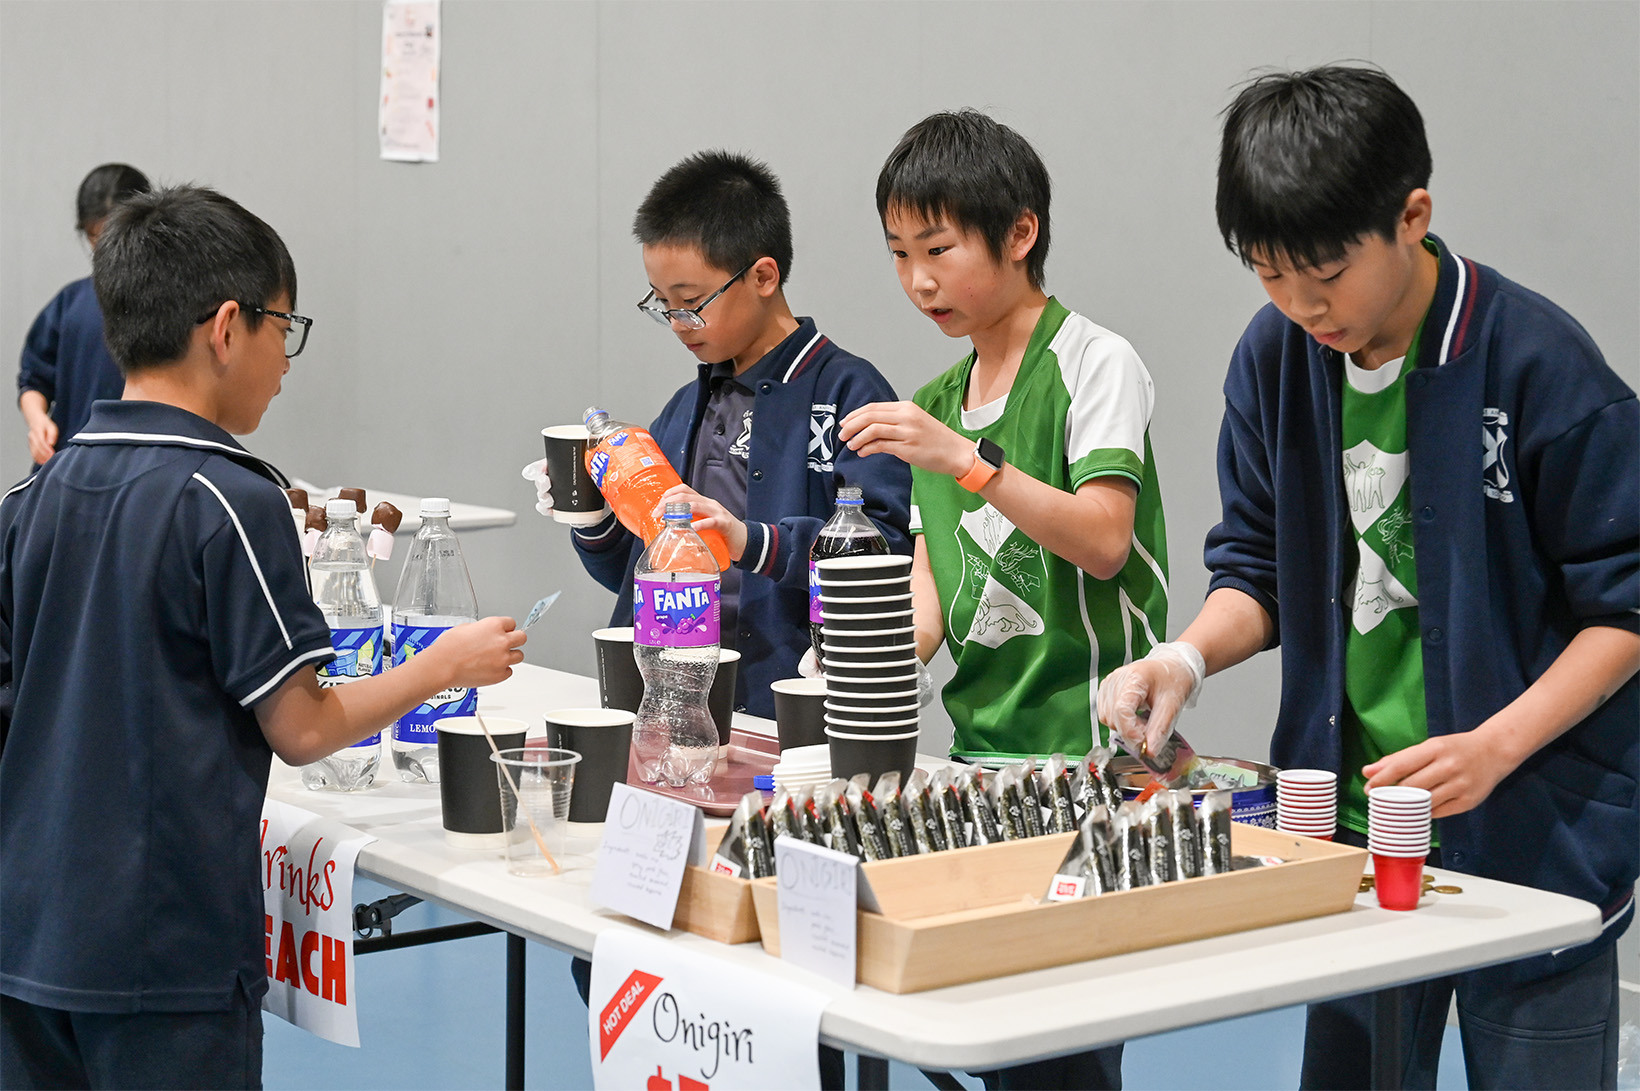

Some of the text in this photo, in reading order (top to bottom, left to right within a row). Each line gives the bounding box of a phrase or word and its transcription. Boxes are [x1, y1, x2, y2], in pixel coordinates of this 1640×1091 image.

[607, 431, 629, 446] FANTA
[653, 586, 710, 611] FANTA
[410, 723, 438, 734] LEMO
[603, 980, 645, 1035] HOT DEAL
[653, 992, 753, 1080] Onigiri
